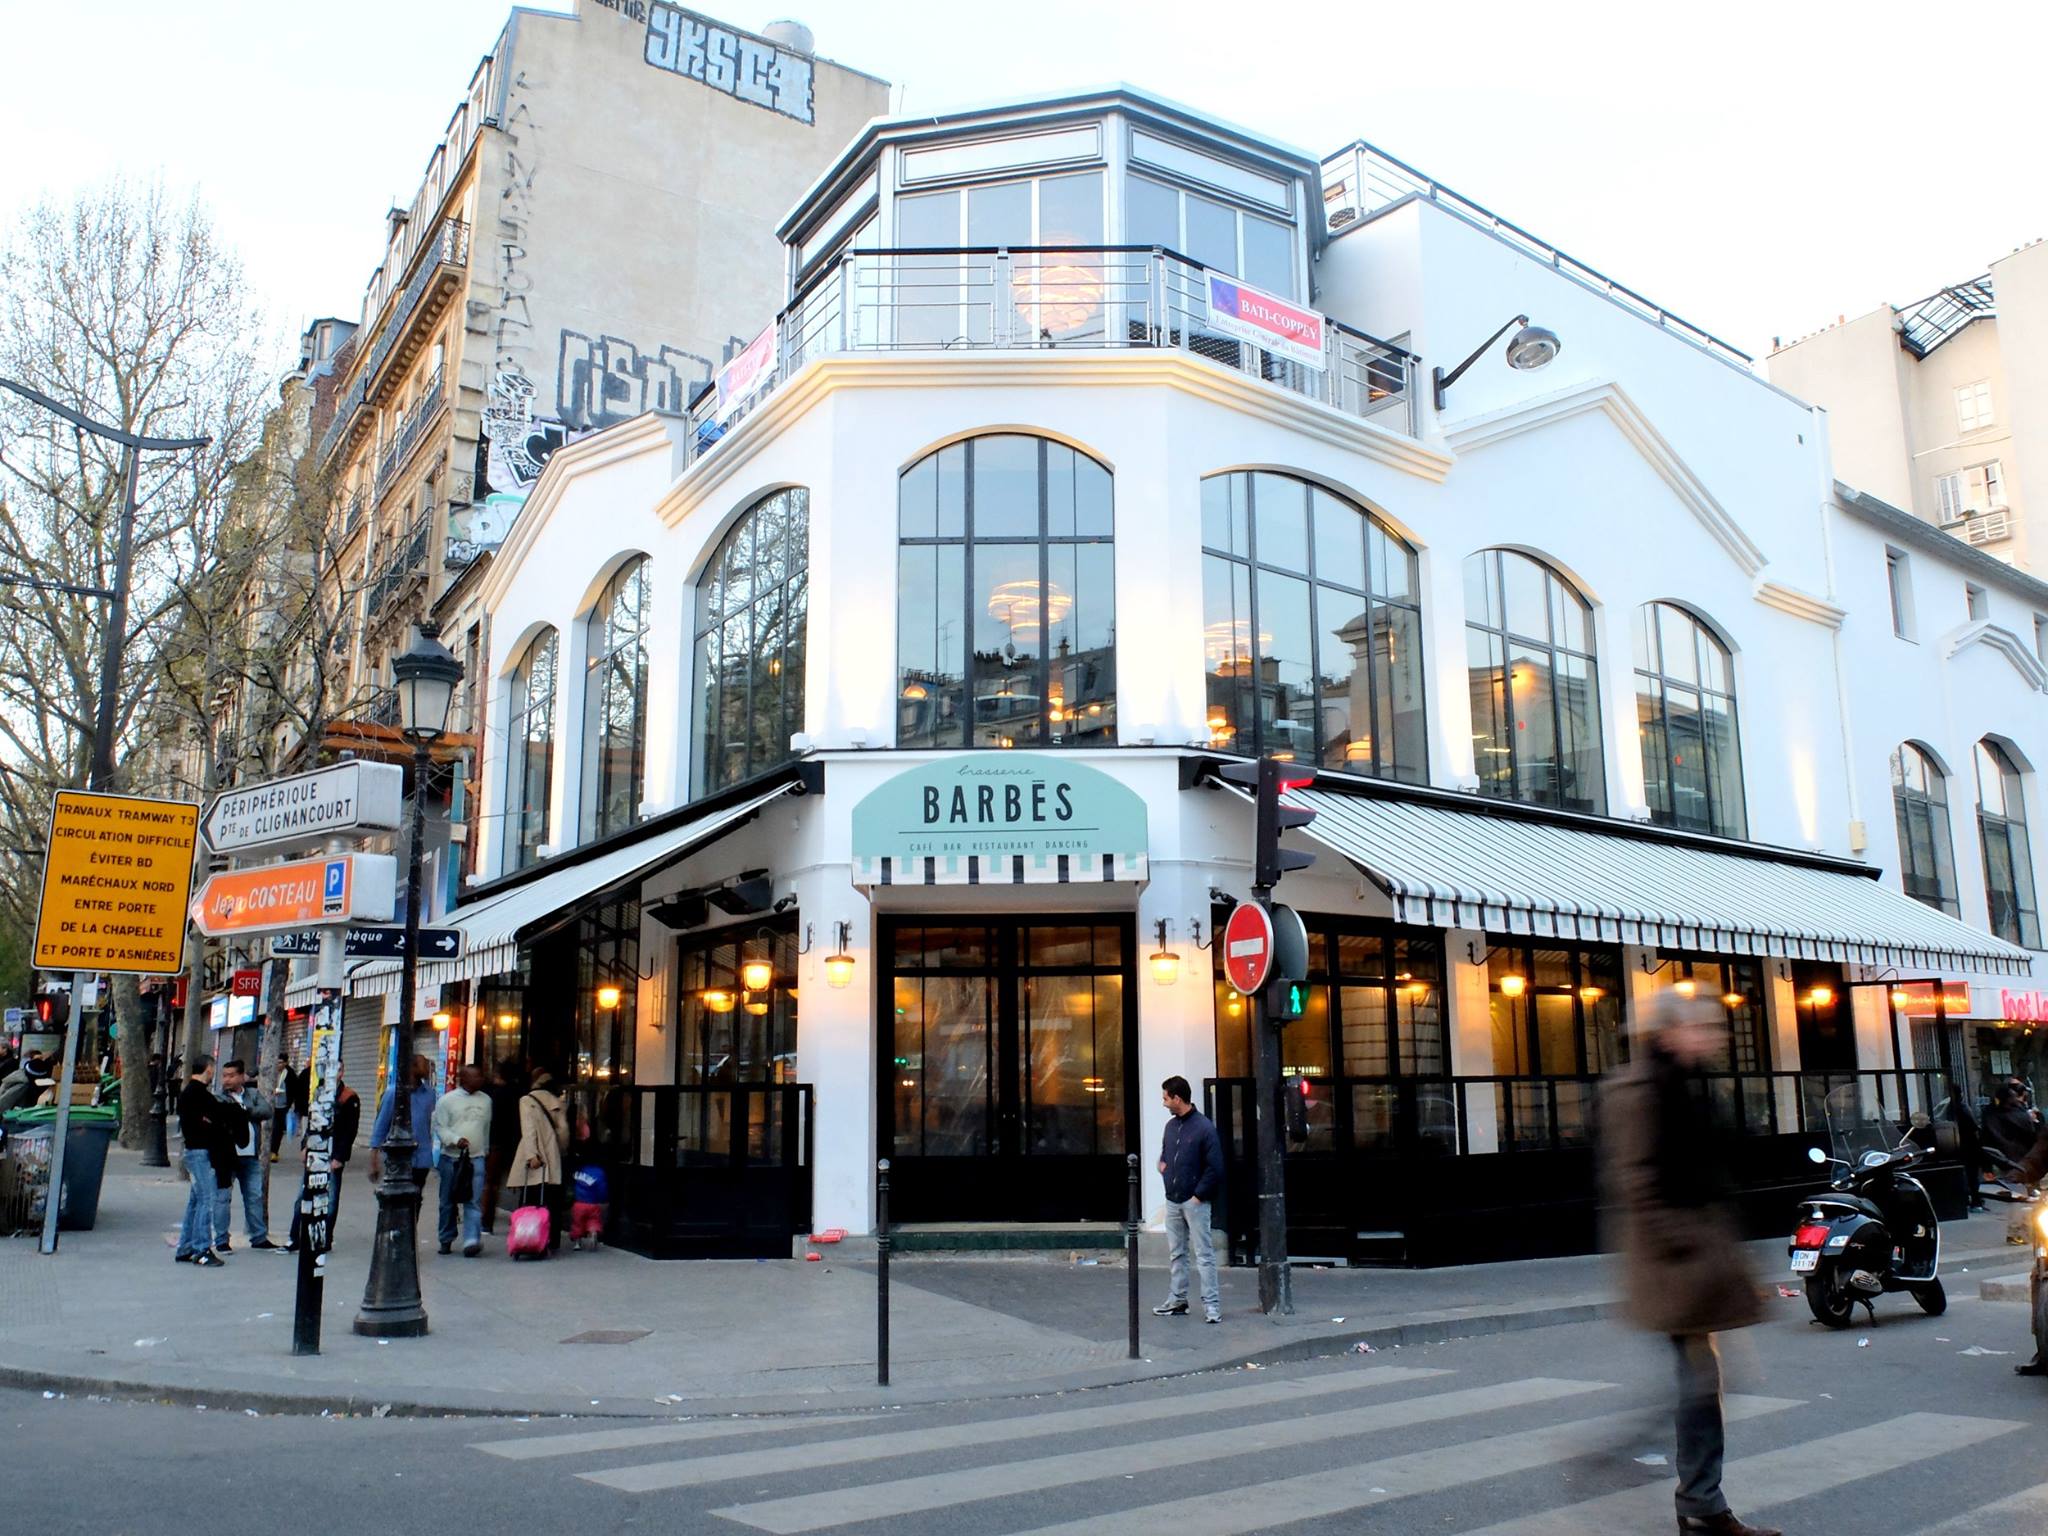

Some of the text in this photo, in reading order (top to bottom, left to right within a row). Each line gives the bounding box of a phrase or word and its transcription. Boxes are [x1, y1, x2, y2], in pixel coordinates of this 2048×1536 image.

[1241, 300, 1317, 341] BATI-COPPEY
[956, 764, 1035, 777] brasserie
[223, 782, 318, 819] PÉRIPHÉRIQUE
[58, 804, 195, 826] TRAVAUX TRAMWAY T3
[255, 799, 351, 835] CLIGNANCOURT
[55, 827, 191, 848] CIRCULATION DIFFICILE
[943, 842, 962, 851] BAR
[973, 841, 1034, 850] RESTAURANT
[1045, 840, 1088, 849] DANCING
[90, 852, 153, 868] ÉVITER BD
[61, 874, 175, 893] MARÉCHAUX NORD
[74, 899, 156, 914] ENTRE PORTE
[61, 922, 163, 937] DE LA CHAPELLE
[41, 945, 57, 955] ET
[62, 945, 101, 958] PORTE
[238, 977, 260, 990] SFR
